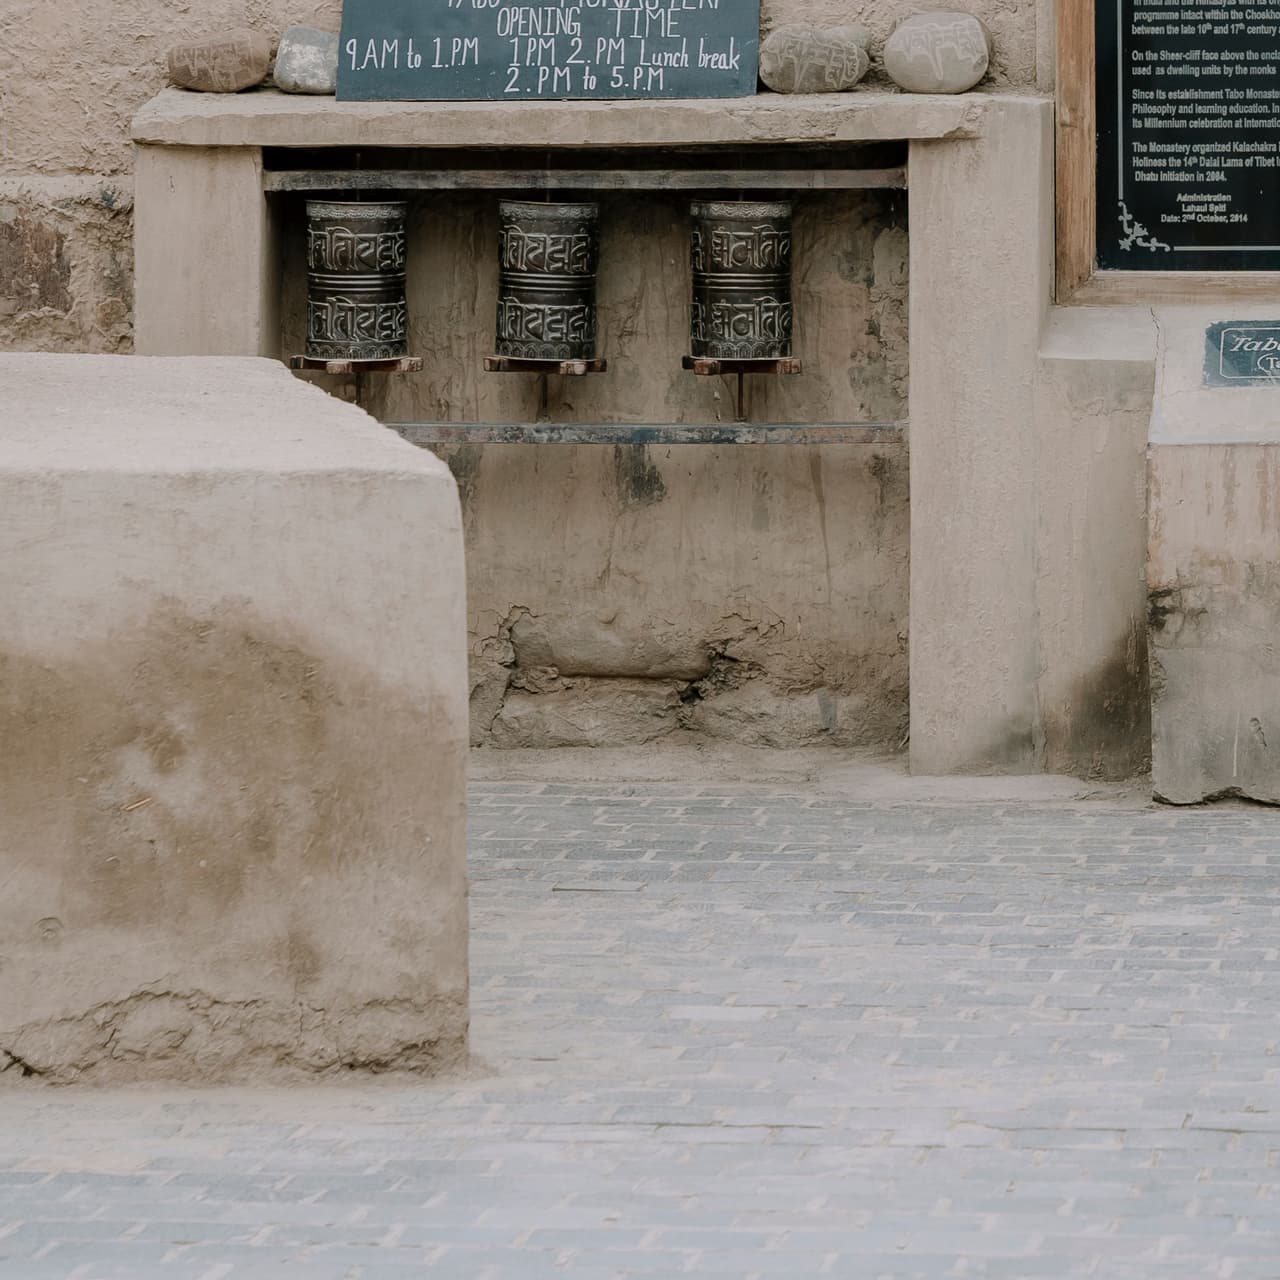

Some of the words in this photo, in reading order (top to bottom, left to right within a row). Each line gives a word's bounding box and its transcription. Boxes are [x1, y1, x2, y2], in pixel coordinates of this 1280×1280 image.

[1133, 12, 1179, 22] programme
[1180, 10, 1203, 19] intact
[1204, 9, 1229, 19] within
[498, 7, 580, 36] OPENING
[608, 7, 680, 38] TIME
[1131, 25, 1165, 34] between
[1180, 24, 1195, 34] late
[1246, 25, 1276, 36] century
[408, 39, 421, 68] to
[639, 37, 689, 67] Lunch
[698, 37, 740, 69] break
[1159, 50, 1200, 60] Sheer-cliff
[1201, 50, 1218, 60] face
[1220, 50, 1244, 60] above
[1131, 65, 1151, 75] used
[1201, 65, 1221, 74] units
[1249, 64, 1276, 74] monks
[583, 66, 596, 89] to
[1131, 89, 1154, 99] Since
[1167, 89, 1223, 99] establishment
[1225, 89, 1244, 99] Tabo
[1132, 104, 1176, 116] Philosophy
[1194, 104, 1227, 116] learning
[1228, 103, 1270, 113] education.
[1143, 118, 1186, 128] Millennium
[1188, 118, 1232, 128] celebration
[1148, 142, 1190, 154] Monastery
[1192, 142, 1230, 154] organized
[1132, 157, 1167, 167] Holiness
[1199, 157, 1219, 167] Dalai
[1221, 157, 1243, 167] Lama
[1255, 156, 1275, 167] Tibet
[1134, 171, 1158, 181] Dhatu
[1176, 193, 1231, 201] Administration
[1181, 204, 1207, 212] Lahaul
[1160, 214, 1180, 222] Date:
[1196, 214, 1228, 223] October,
